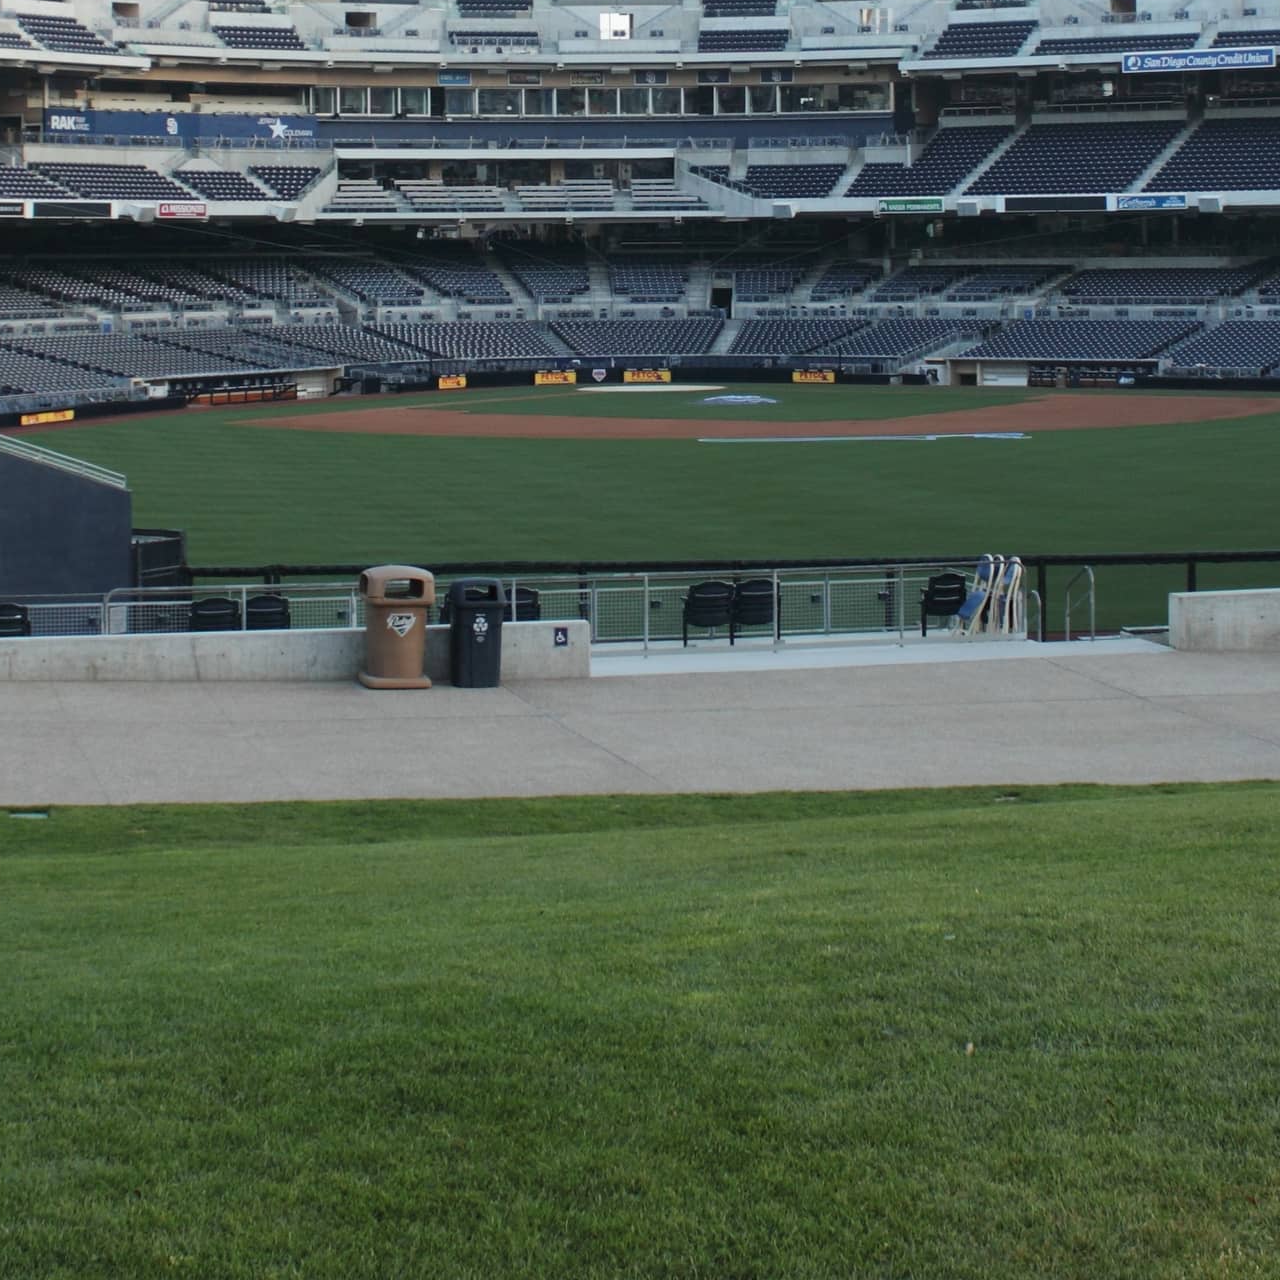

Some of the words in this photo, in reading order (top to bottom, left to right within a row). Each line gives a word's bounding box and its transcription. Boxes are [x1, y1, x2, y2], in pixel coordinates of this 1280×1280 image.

[1143, 57, 1160, 68] San
[1160, 56, 1186, 68] Diego
[1186, 55, 1217, 66] County
[1217, 53, 1243, 65] Credit
[1243, 52, 1270, 64] Union
[51, 115, 76, 130] RAK
[632, 371, 658, 380] PETCO
